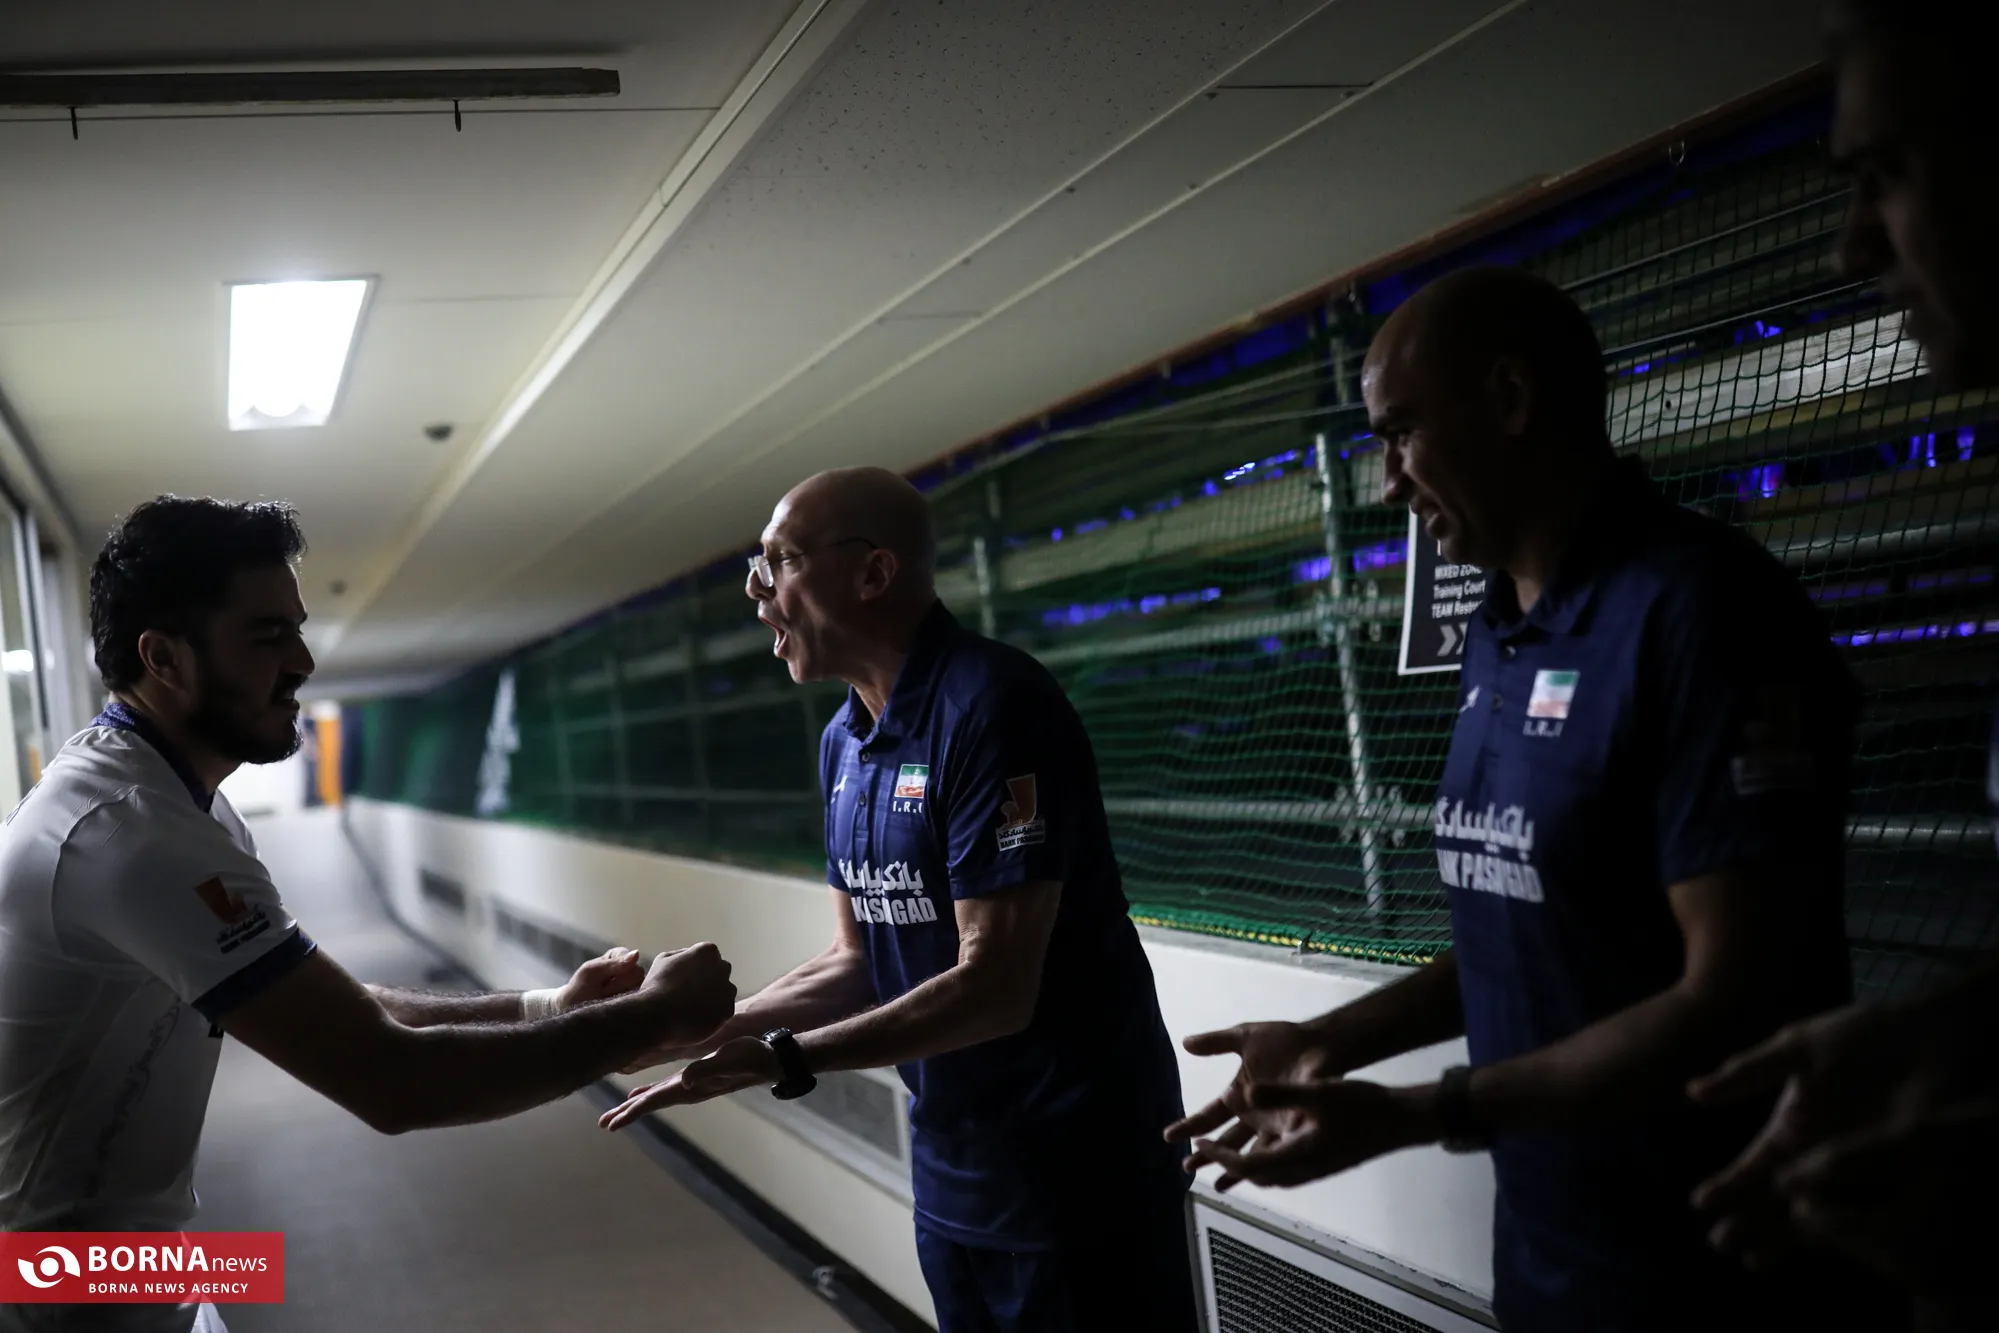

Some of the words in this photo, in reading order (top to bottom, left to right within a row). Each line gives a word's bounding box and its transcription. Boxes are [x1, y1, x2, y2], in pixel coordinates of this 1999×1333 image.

[1434, 564, 1460, 581] MIXED
[1433, 582, 1463, 600] Training
[1464, 579, 1487, 596] Court
[1432, 601, 1454, 619] TEAM
